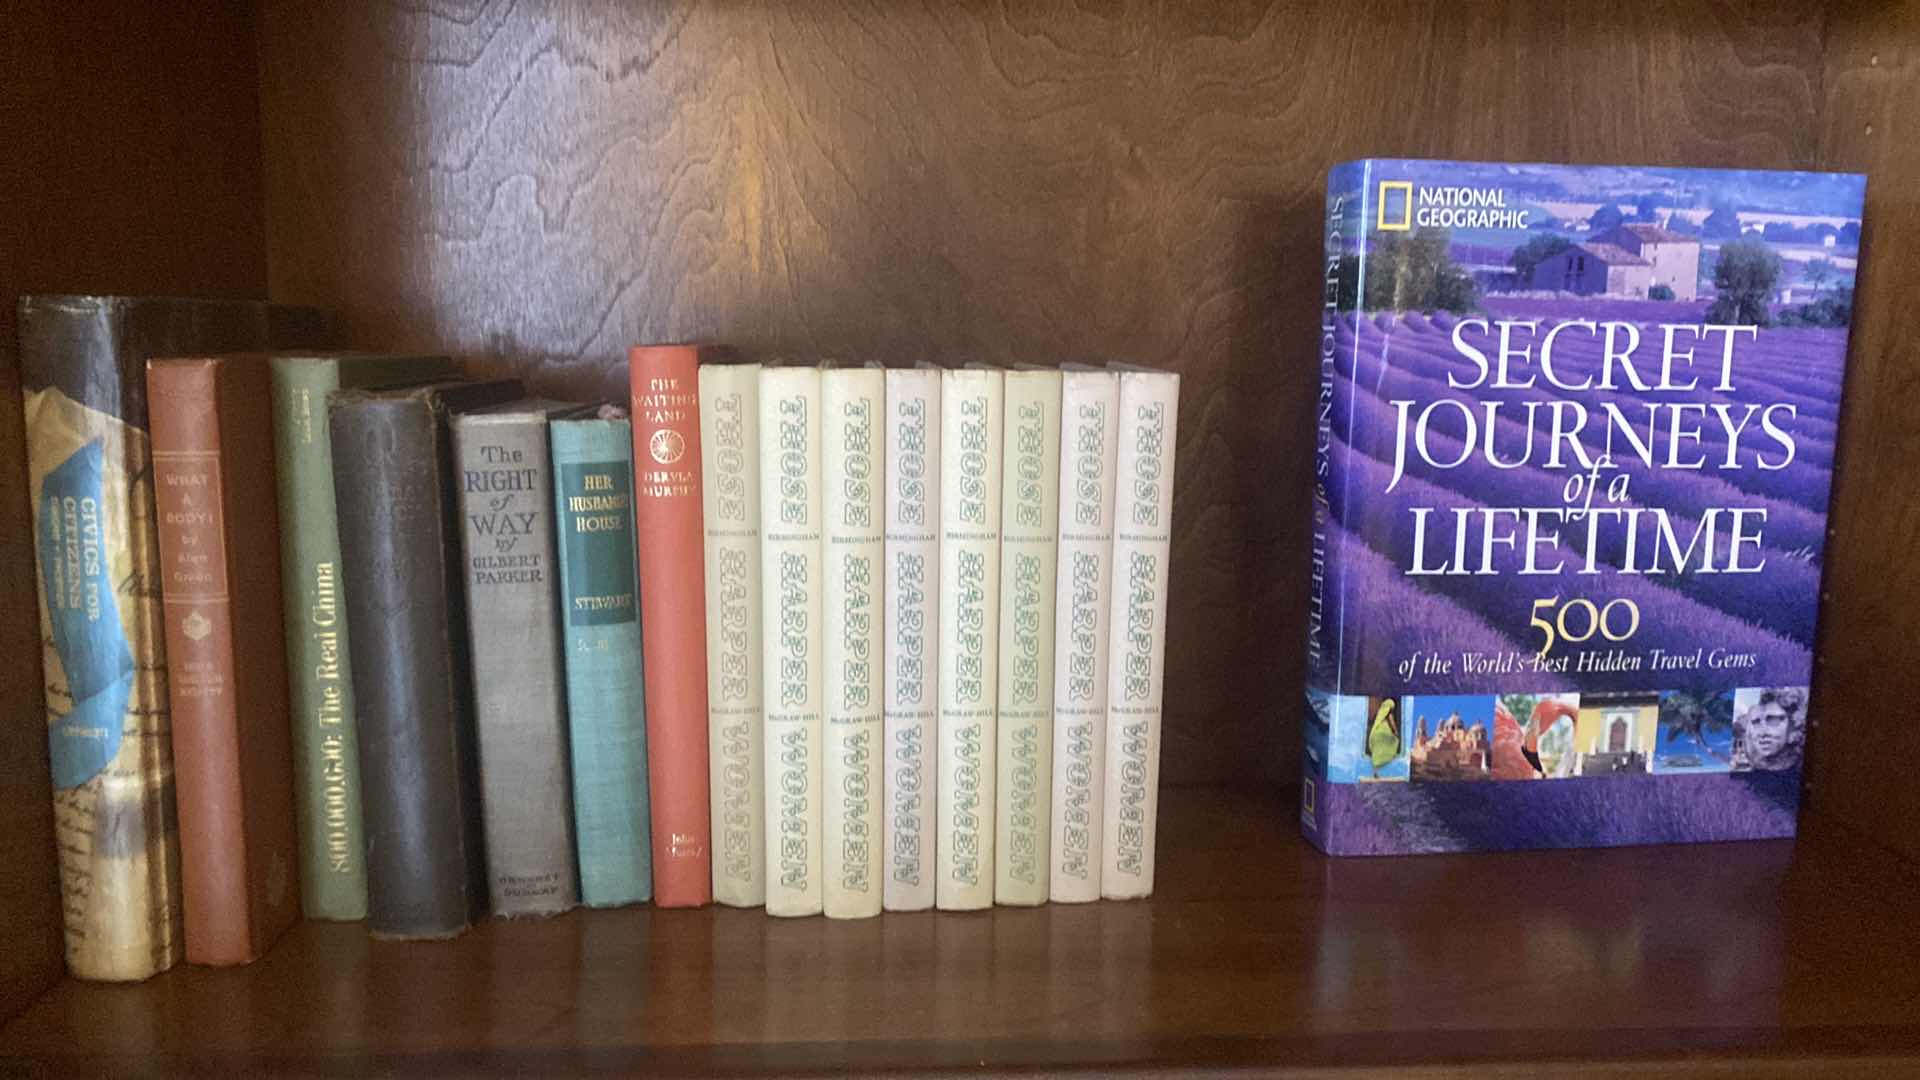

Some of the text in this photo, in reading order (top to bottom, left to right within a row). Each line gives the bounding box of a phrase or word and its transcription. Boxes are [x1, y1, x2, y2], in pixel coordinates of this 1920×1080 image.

[1416, 207, 1529, 230] GEOGRAPHIC
[1418, 187, 1507, 208] NATIONAL
[1326, 196, 1343, 315] SECRET
[651, 378, 679, 391] THE
[1447, 318, 1758, 392] SECRET
[1317, 324, 1336, 477] JOURNEYS
[481, 446, 522, 464] The
[1386, 400, 1798, 495] JOURNEYS
[166, 473, 208, 487] WHAT
[183, 492, 192, 505] A
[464, 469, 537, 493] RIGHT
[490, 494, 514, 512] of
[584, 474, 614, 490] HER
[1563, 456, 1629, 519] of a
[63, 496, 81, 608] CITIZENS
[470, 512, 539, 536] WAY
[495, 536, 519, 551] by
[575, 515, 623, 533] HOUSE
[1405, 506, 1769, 576] LIFETIME
[80, 497, 100, 622] CIVICS FOR
[472, 554, 542, 570] GILBERT
[476, 568, 543, 584] PARKER
[311, 562, 336, 627] China
[1306, 532, 1325, 669] LIFETIME
[313, 632, 340, 680] Real
[714, 394, 750, 882] THOSE HARPER WOMEN
[779, 395, 808, 891] THOSE HARPER WOMEN
[843, 396, 872, 893] THOSE HARPER WOMEN
[894, 397, 926, 886] THOSE HARPER WOMEN
[952, 396, 988, 887] THOSE HARPER WOMEN
[1009, 401, 1044, 884] THOSE HARPER WOMEN
[1062, 401, 1105, 880] THOSE HARPER WOMEN
[1117, 401, 1164, 877] THOSE HARPER WOMEN
[1529, 595, 1641, 660] 500
[1398, 648, 1757, 683] of the World's Best Hidden Travel Gems
[317, 686, 342, 729] The
